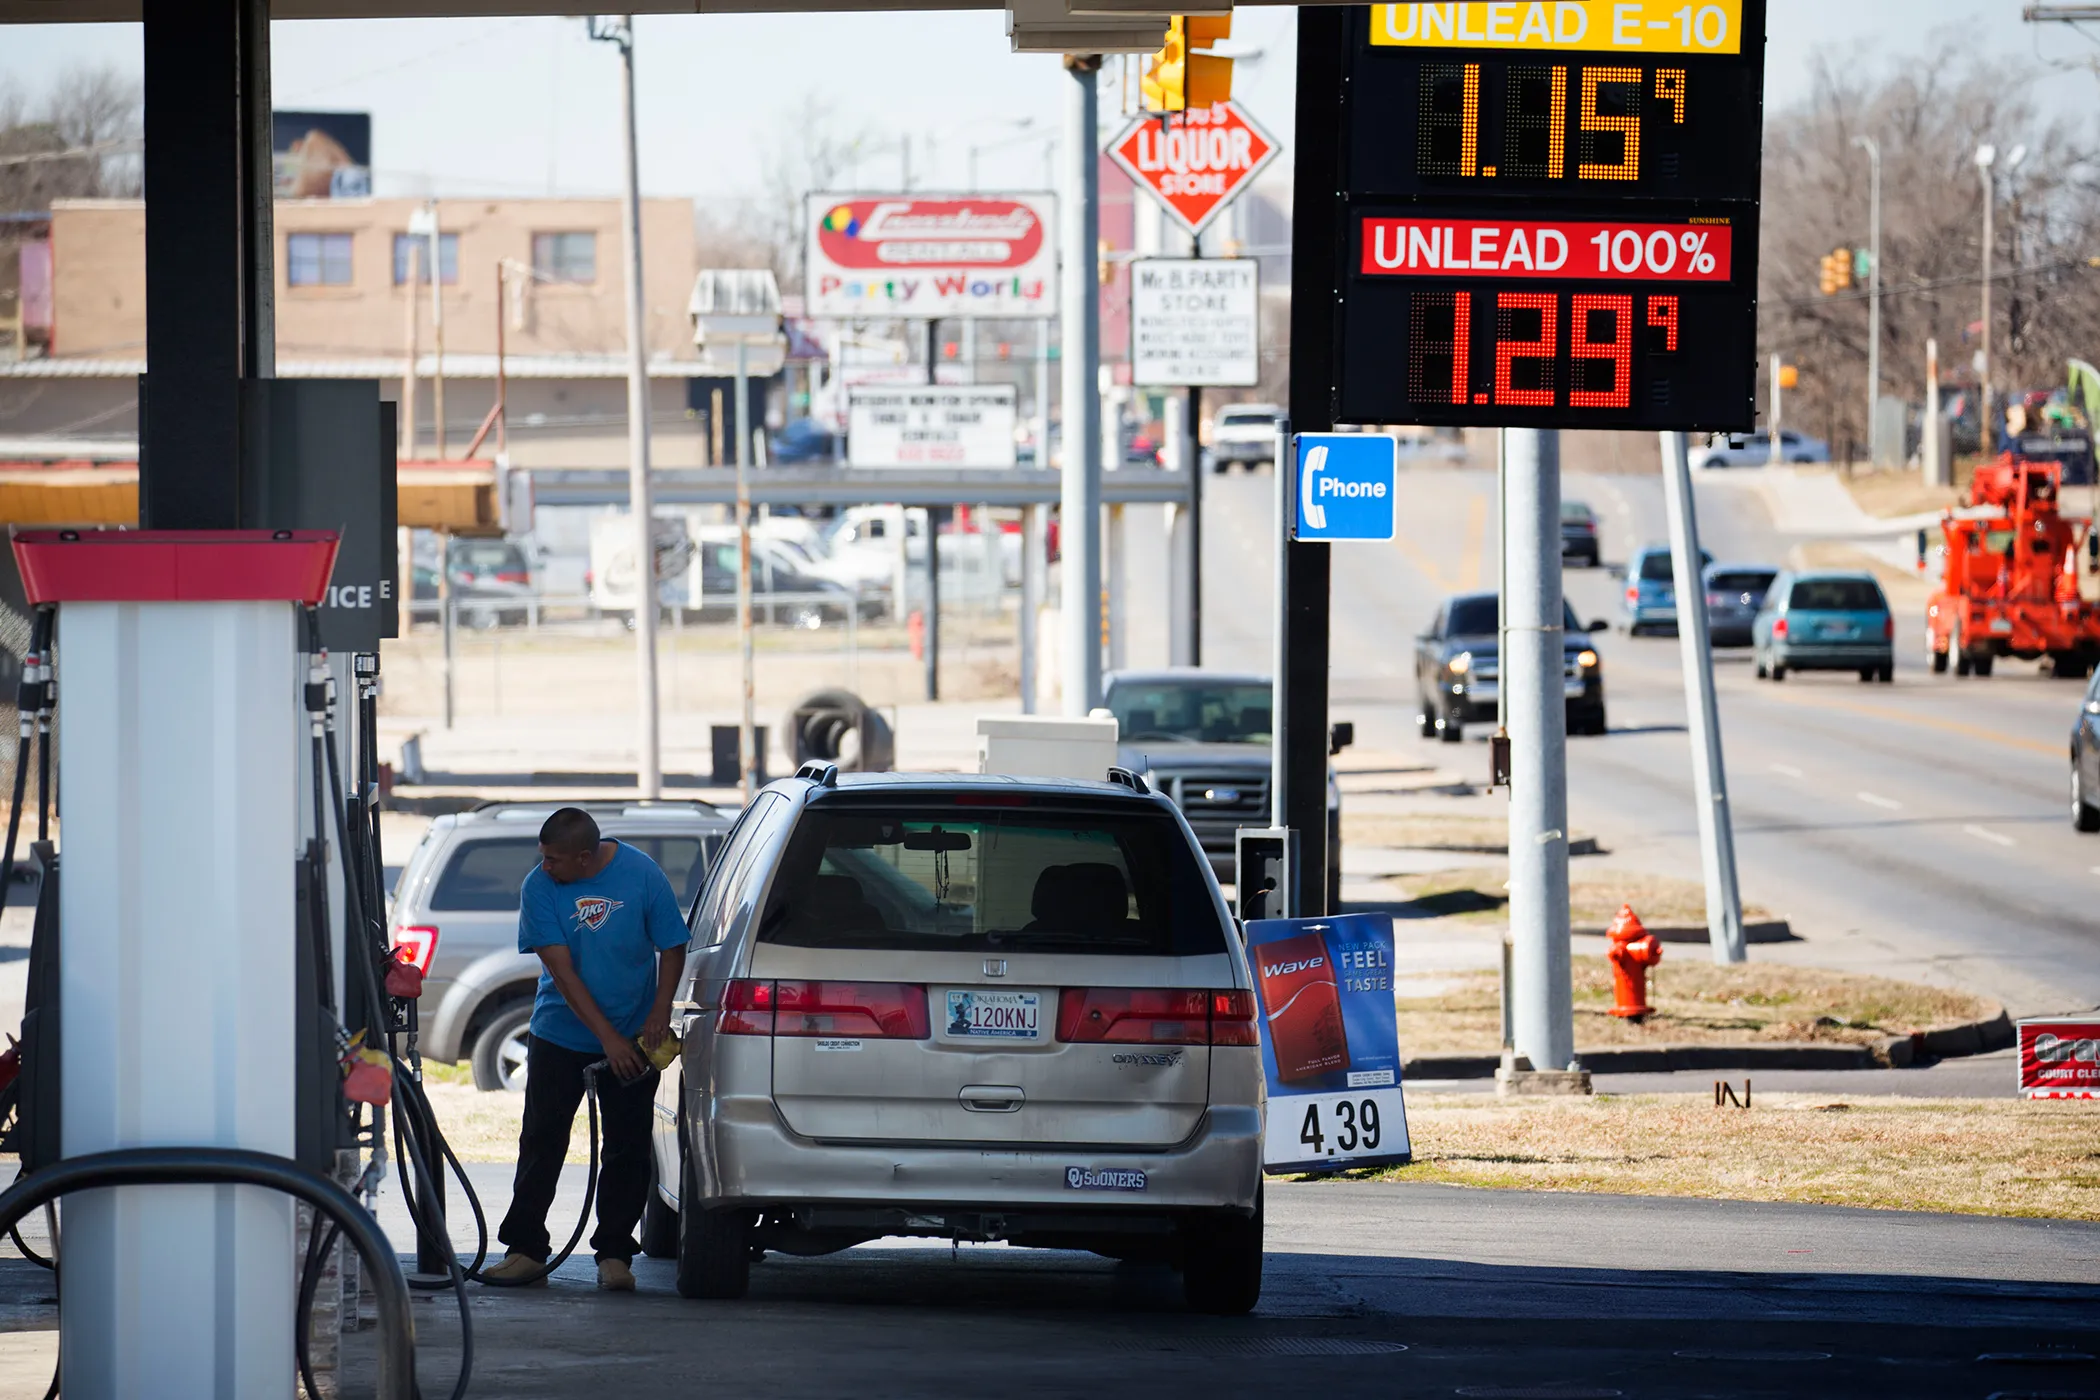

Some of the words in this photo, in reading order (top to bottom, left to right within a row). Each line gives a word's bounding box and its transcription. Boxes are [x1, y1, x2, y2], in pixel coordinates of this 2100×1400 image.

[1386, 3, 1588, 43] UNLEAD
[1612, 4, 1728, 48] E-10
[1137, 128, 1253, 174] LIQUOR
[1160, 173, 1227, 196] STORE
[1689, 217, 1731, 225] SUNSHINE
[1373, 225, 1569, 271] UNLEAD
[1591, 230, 1716, 275] 100%
[820, 275, 919, 300] Party
[935, 274, 1045, 300] World
[1160, 294, 1227, 312] STORE
[1319, 477, 1387, 498] Phone
[328, 585, 372, 608] ICE
[580, 902, 604, 922] OKC
[1338, 943, 1359, 951] NEW
[1363, 941, 1386, 949] PACK
[1264, 957, 1325, 978] Wave
[1341, 950, 1387, 968] FEEL
[1345, 977, 1388, 992] TASTE
[971, 994, 1018, 1005] OKLAHOMA
[973, 1007, 1037, 1028] 120KNJ
[1112, 1053, 1176, 1067] ODYSSEY
[1322, 1053, 1341, 1062] FLAVOR
[2038, 1069, 2075, 1079] COURT
[2077, 1069, 2100, 1079] CLE
[1300, 1098, 1381, 1156] 4.39
